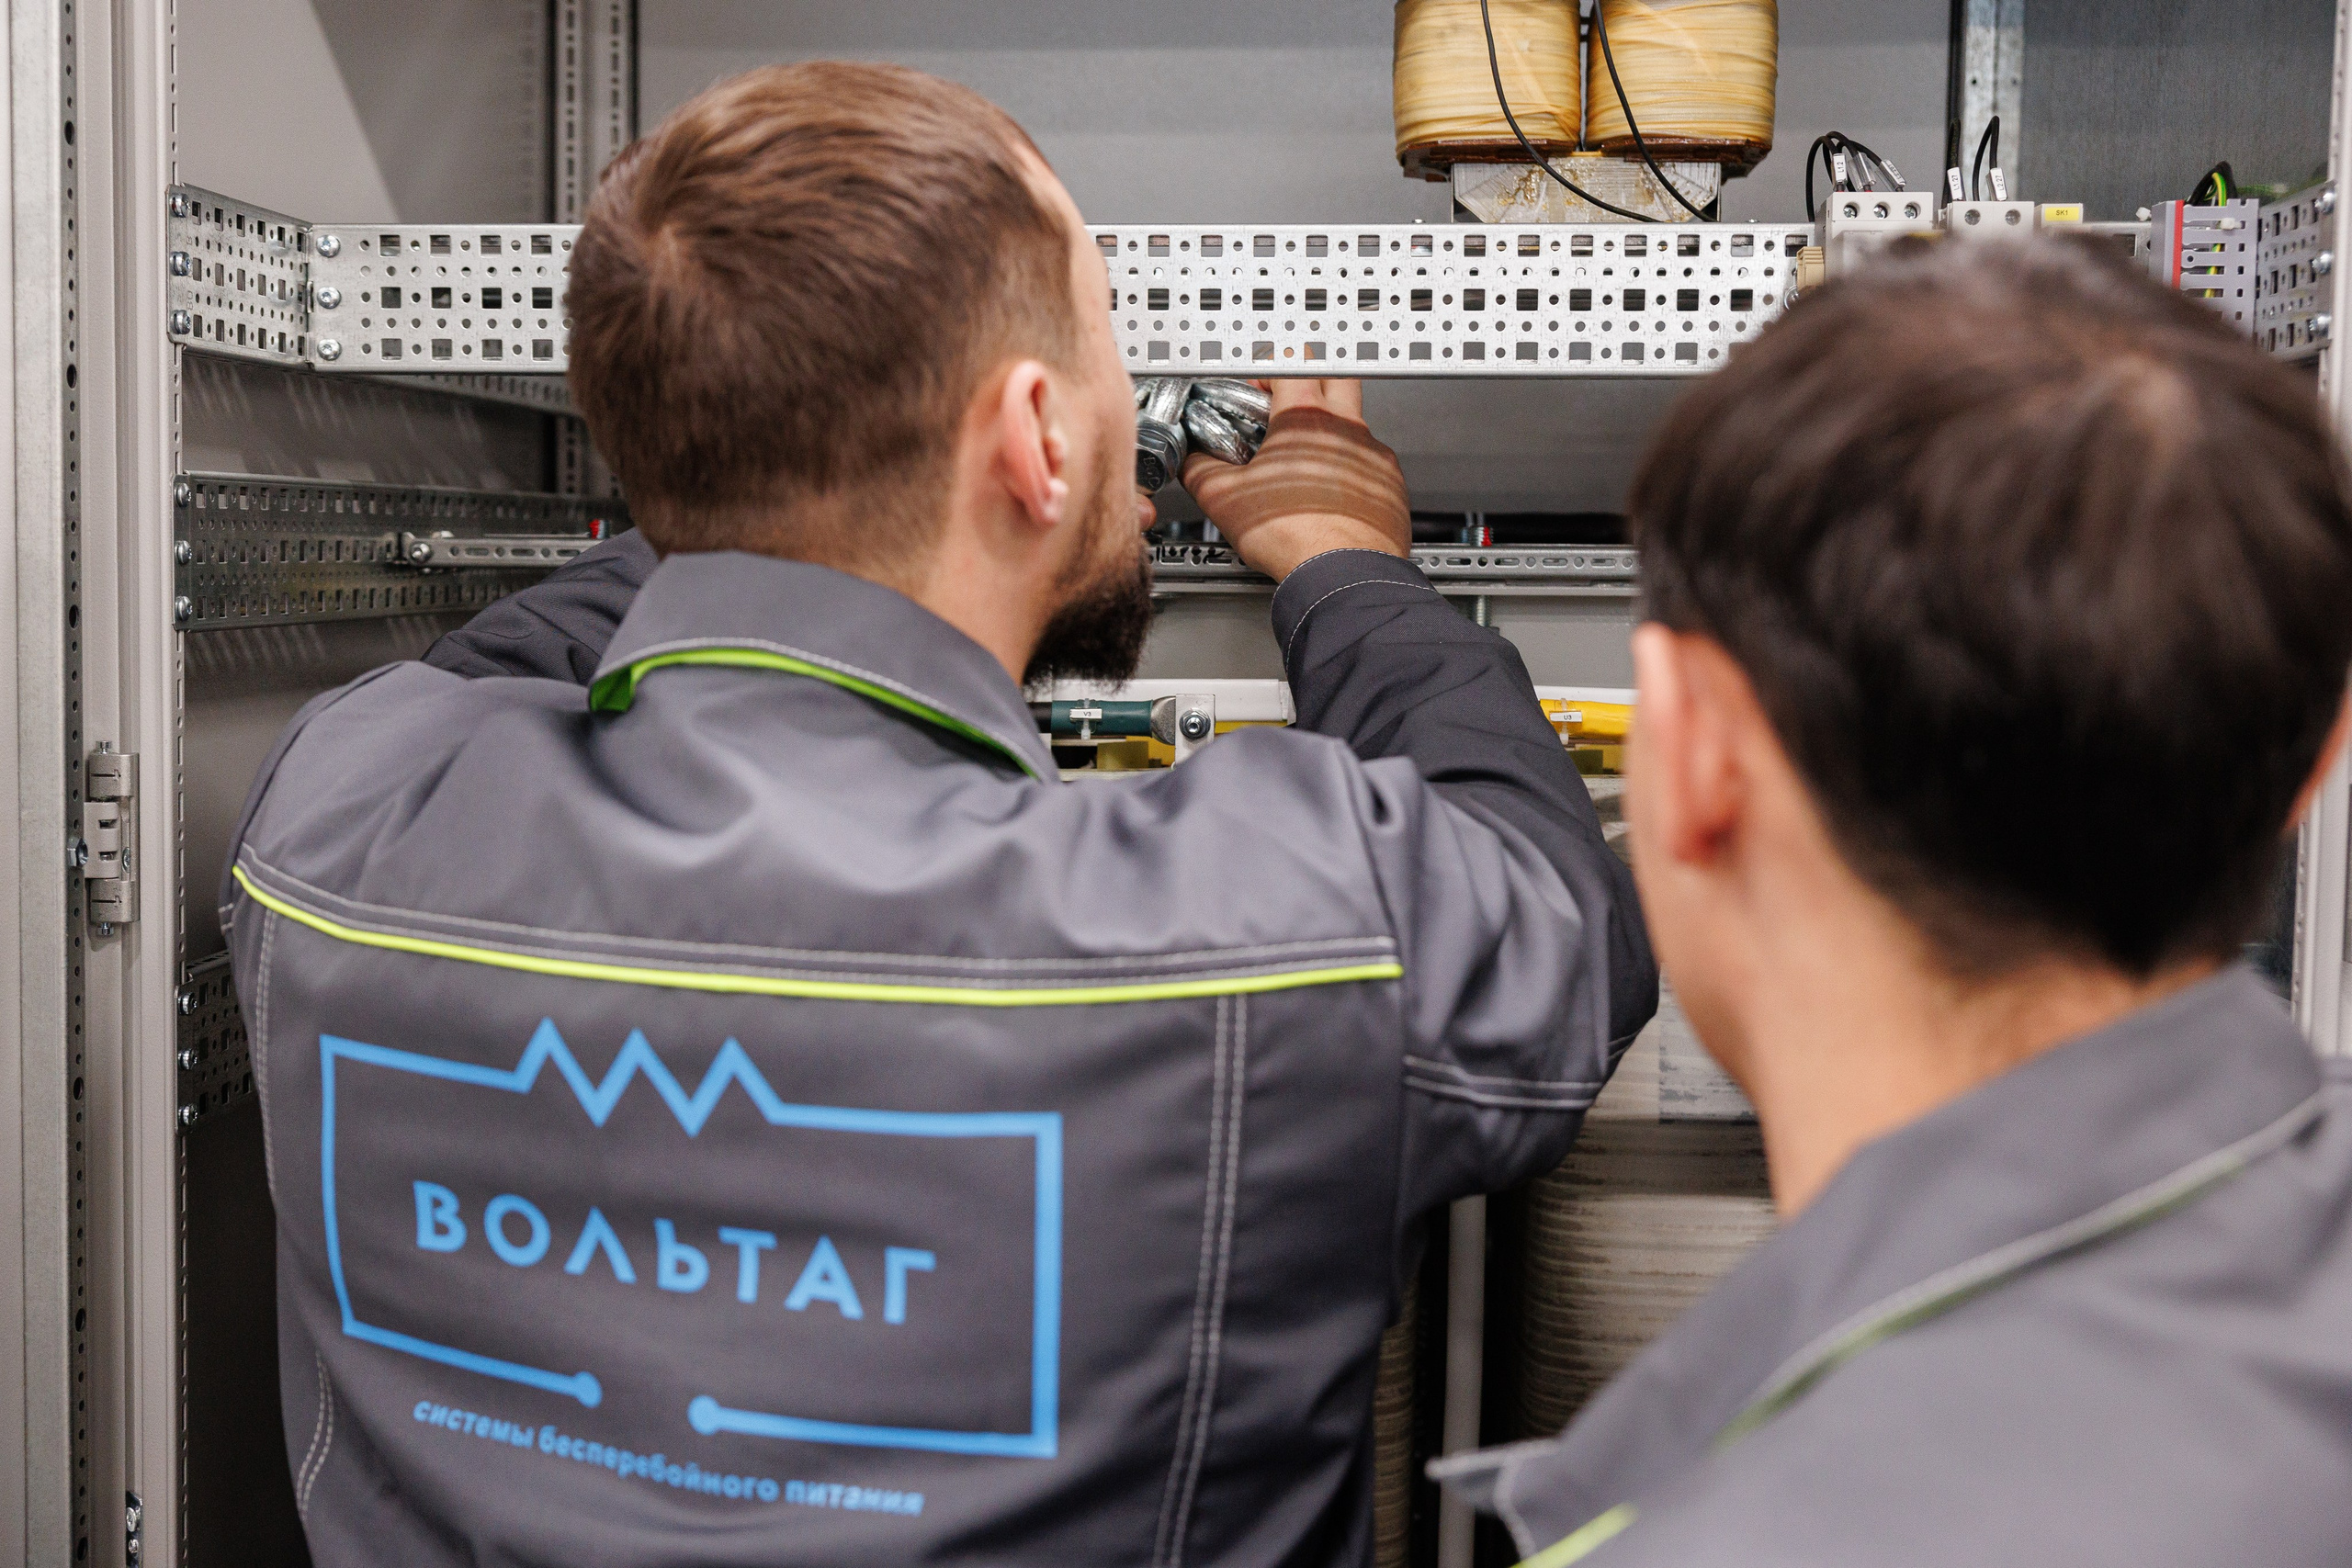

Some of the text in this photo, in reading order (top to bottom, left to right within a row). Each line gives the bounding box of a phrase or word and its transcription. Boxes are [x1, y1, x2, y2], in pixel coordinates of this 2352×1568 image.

[413, 1179, 937, 1325] ВОЛЬТАГ
[413, 1400, 925, 1517] системы бесперебойного питания
